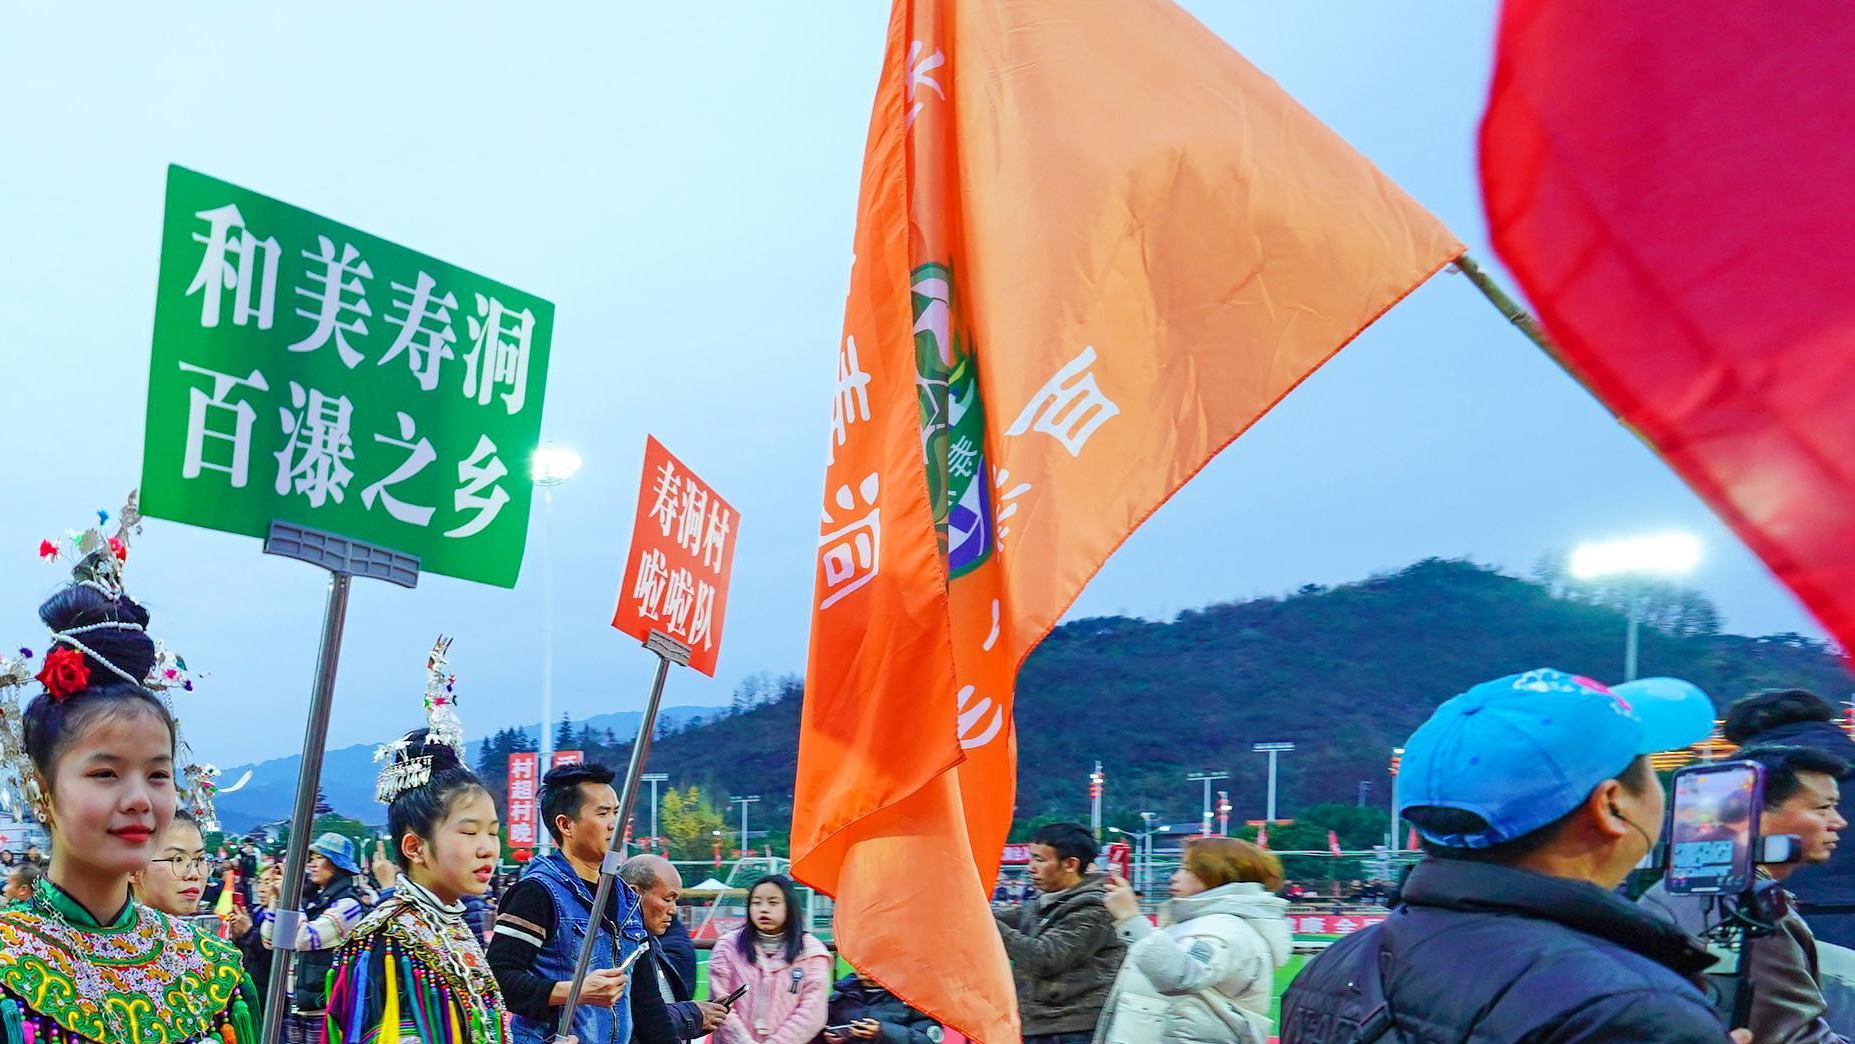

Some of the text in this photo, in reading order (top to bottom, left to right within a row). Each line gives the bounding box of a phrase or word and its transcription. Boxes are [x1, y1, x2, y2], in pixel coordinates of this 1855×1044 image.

[185, 203, 535, 416] 和美寿洞
[178, 360, 511, 538] 百瀑之乡
[648, 460, 730, 575] 寿洞村
[633, 548, 715, 652] 啦啦队
